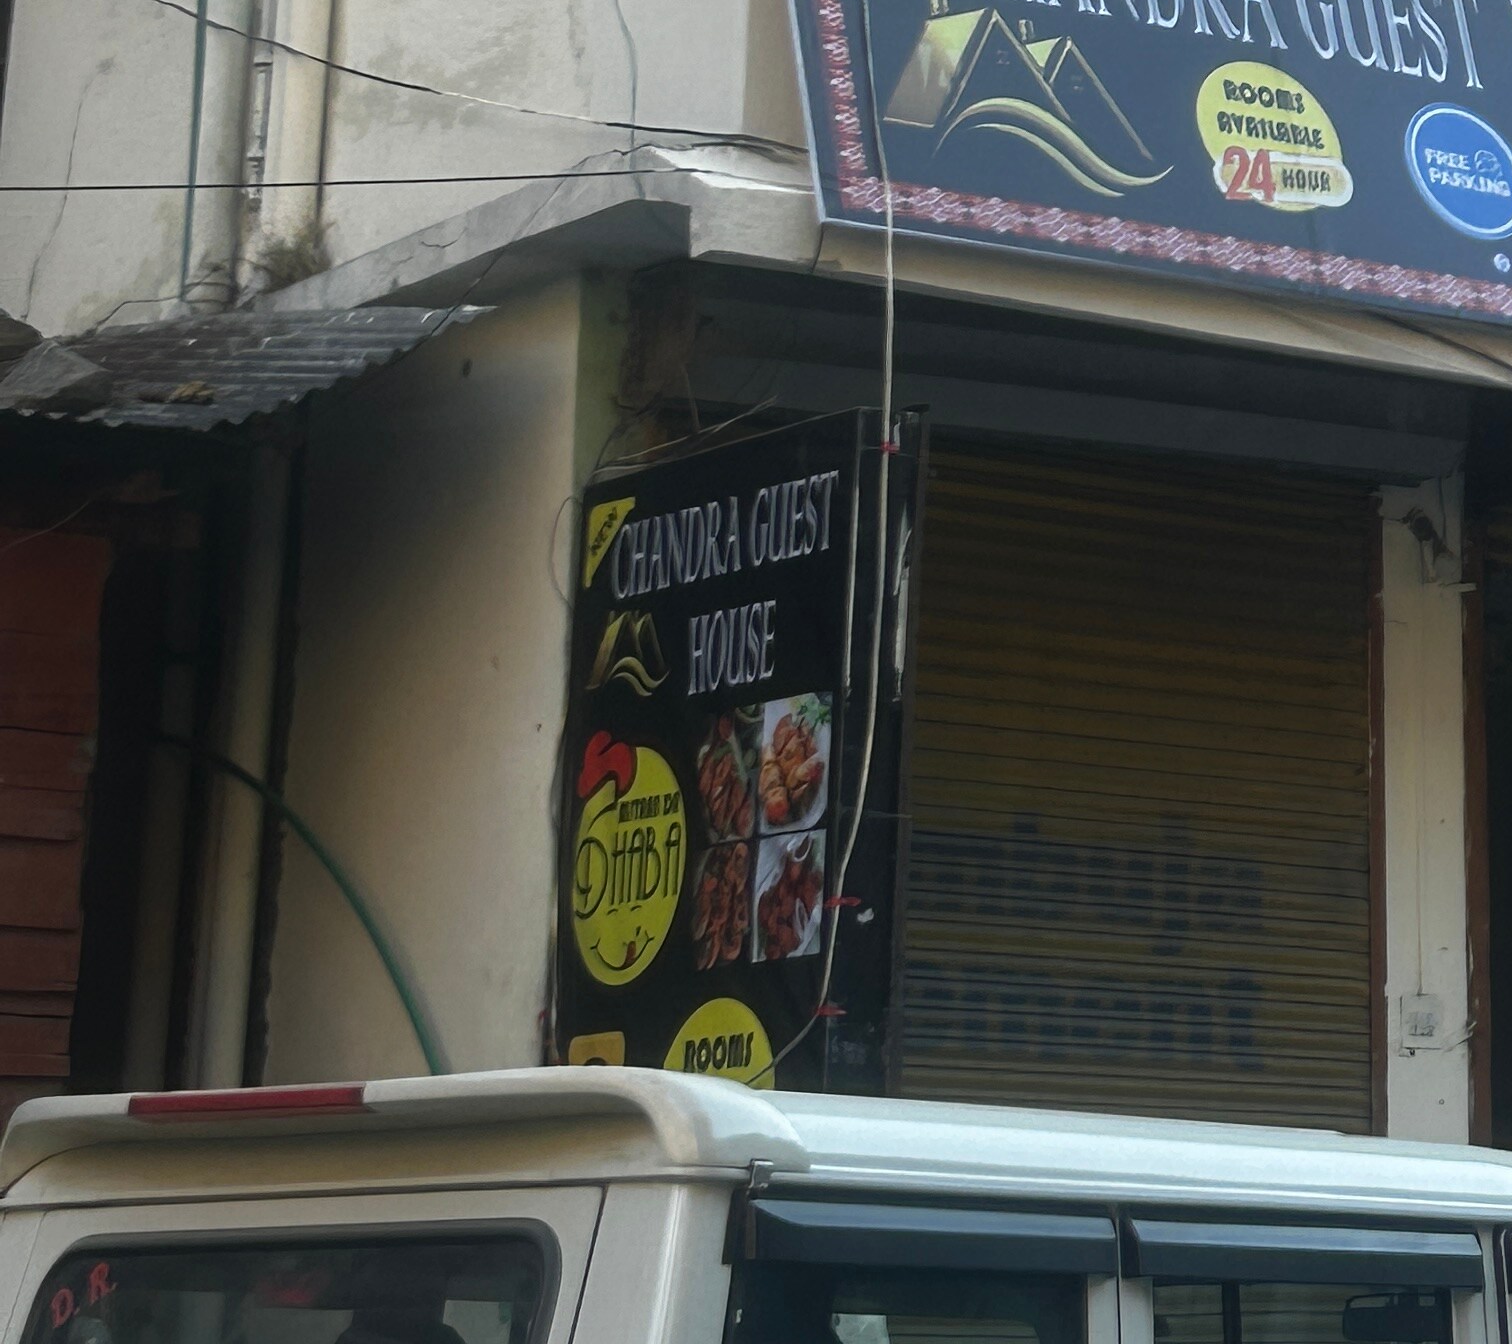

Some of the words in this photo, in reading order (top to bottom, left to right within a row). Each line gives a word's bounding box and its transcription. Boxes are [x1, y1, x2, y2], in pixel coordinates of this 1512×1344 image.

[1223, 79, 1305, 114] ROOMS
[1222, 146, 1276, 203] 24
[1424, 148, 1471, 170] FREE
[1428, 167, 1512, 197] PARKING
[613, 496, 742, 599] CHANDRA
[749, 470, 838, 567] GUEST
[688, 599, 777, 696] HOUSE
[576, 822, 681, 919] DHABA
[684, 1032, 754, 1073] ROOMS
